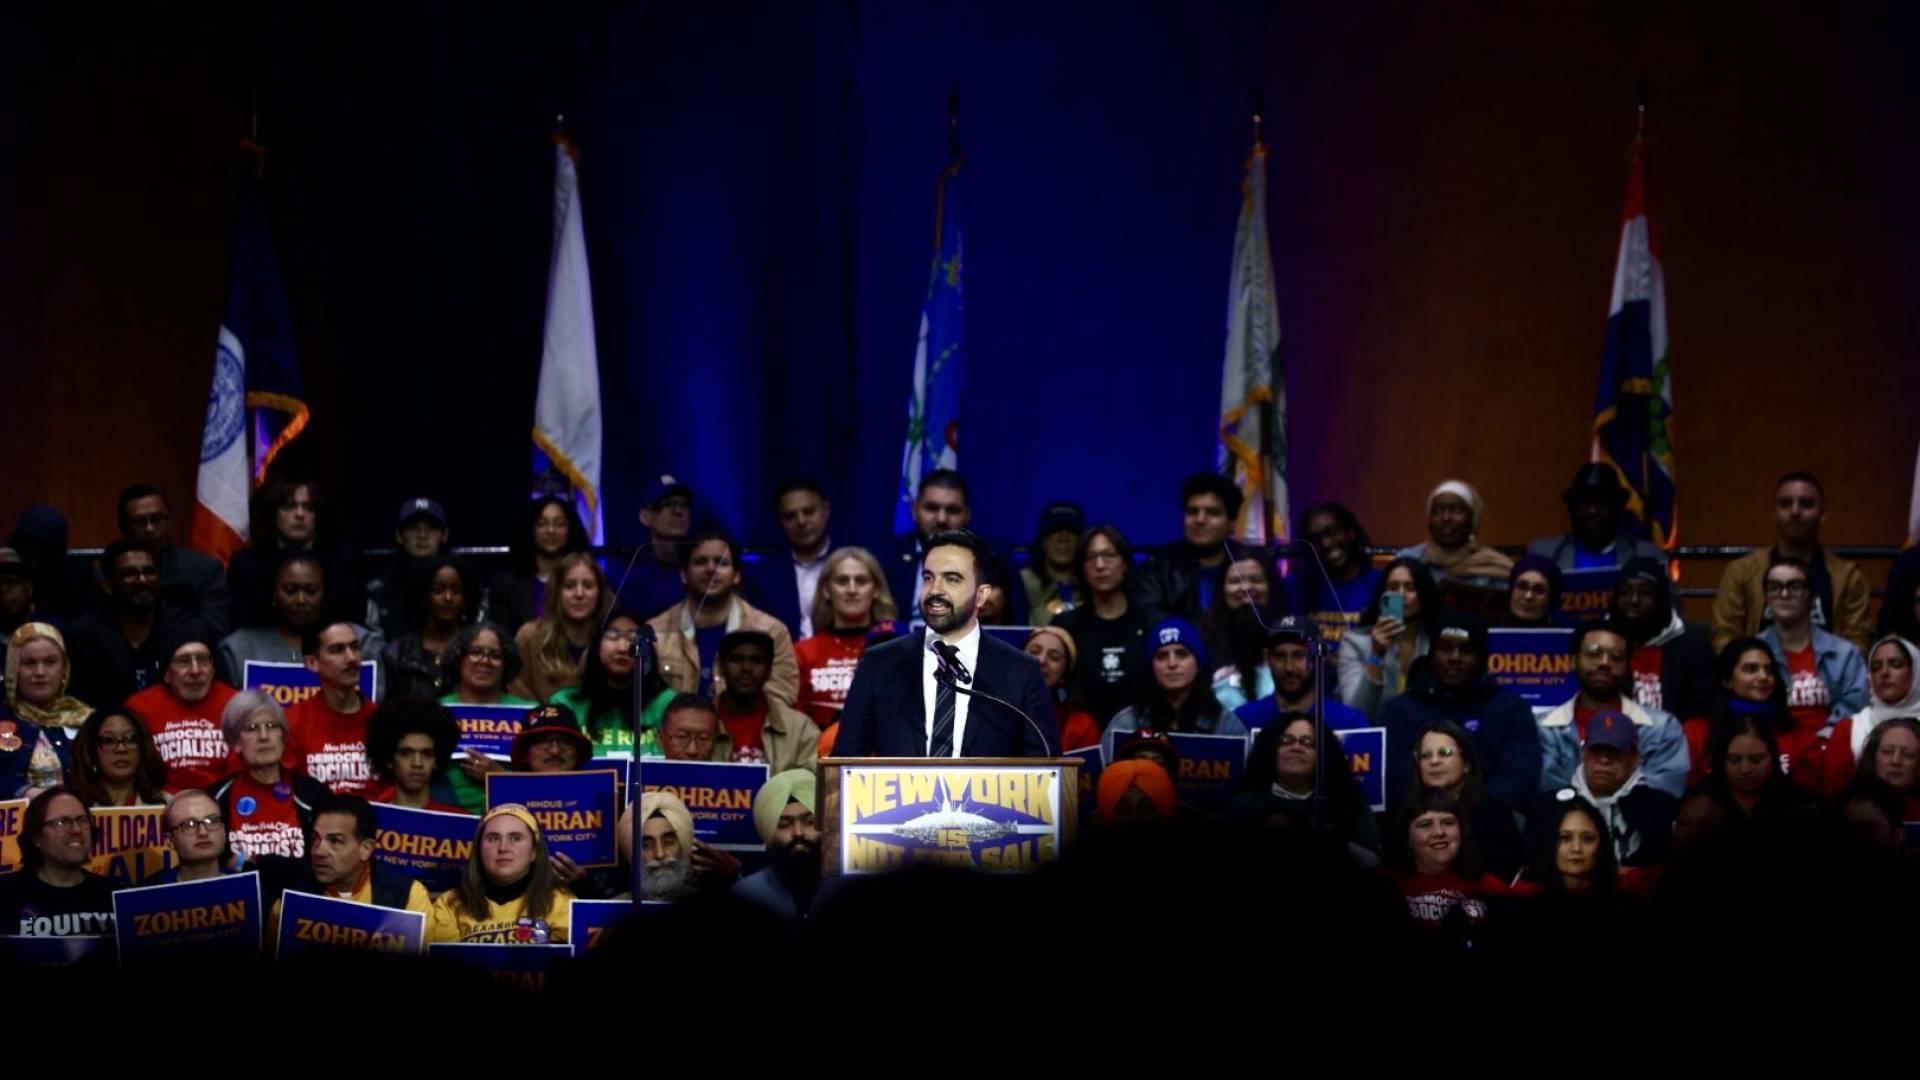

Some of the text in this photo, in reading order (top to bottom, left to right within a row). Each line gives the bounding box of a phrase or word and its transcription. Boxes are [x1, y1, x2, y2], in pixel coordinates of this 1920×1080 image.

[1487, 652, 1572, 675] OHRAN
[721, 812, 747, 821] CITY
[850, 771, 1054, 826] NEW YORK
[575, 832, 598, 841] CITY
[849, 834, 905, 871] NOT
[937, 828, 968, 847] IS
[980, 832, 1056, 872] SALE
[133, 900, 247, 937] ZOHRAN
[296, 918, 406, 954] ZOHRAN
